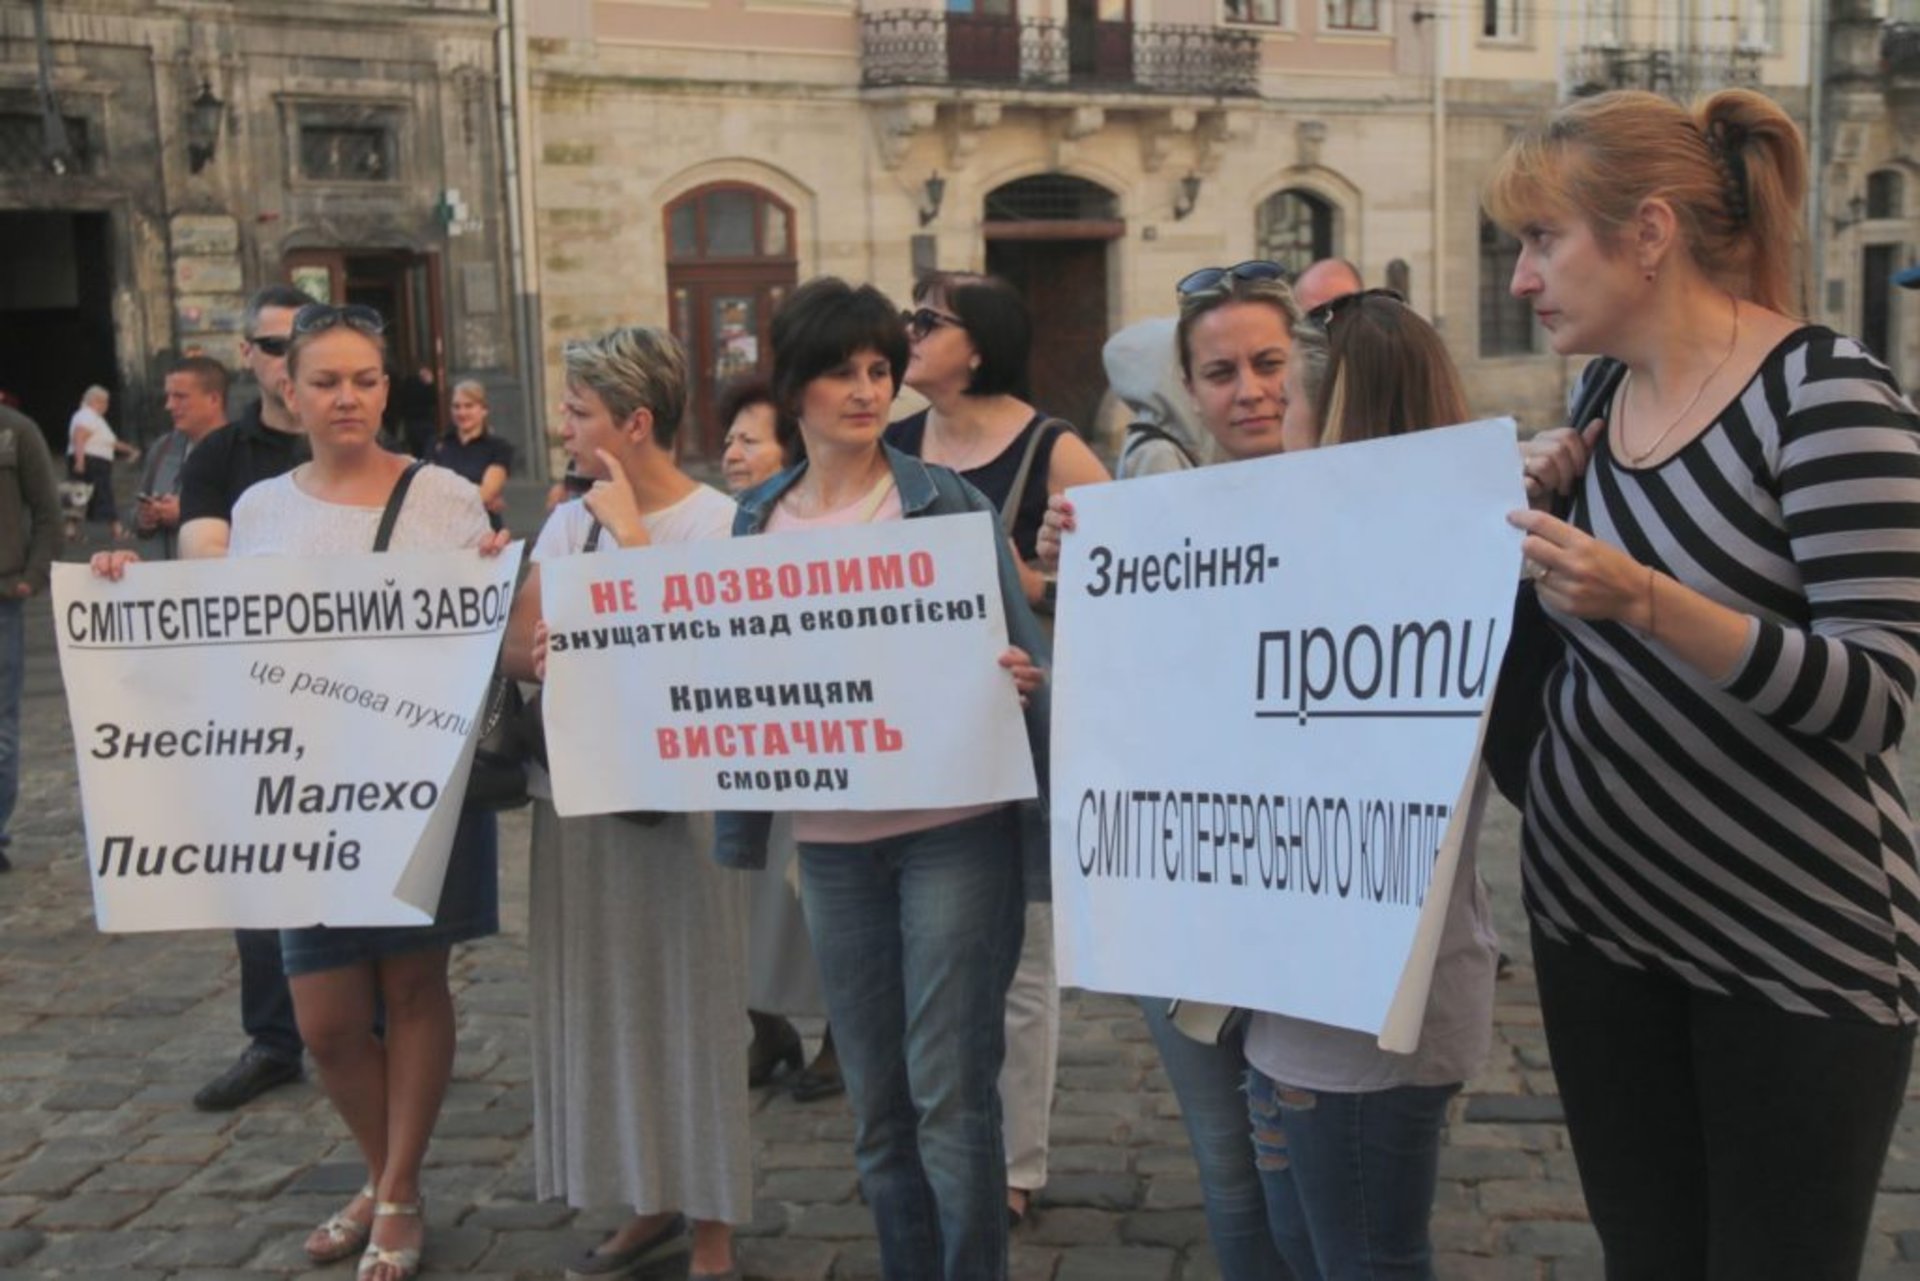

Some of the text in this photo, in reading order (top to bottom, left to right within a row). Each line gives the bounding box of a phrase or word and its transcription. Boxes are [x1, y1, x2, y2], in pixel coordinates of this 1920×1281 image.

[589, 550, 936, 614] НЕ ДОЗВОЛИМО
[1086, 537, 1280, 598] Знесіння-
[66, 578, 511, 644] СМІТТЄПЕРЕРОБНИЙ ЗАВОД
[549, 594, 988, 653] знущатись над екологією!
[249, 658, 285, 687] це
[289, 670, 390, 713] ракова
[669, 680, 874, 712] Кривчицям
[1256, 617, 1496, 727] проти
[91, 721, 306, 760] Знесіння,
[655, 718, 904, 760] ВИСТАЧИТЬ
[254, 775, 440, 816] Малехо
[717, 766, 850, 792] смороду
[98, 831, 362, 878] Лисиничів
[1077, 788, 1451, 908] СМІТТЄПЕРЕРОБНОГО КОМПЛЕ
